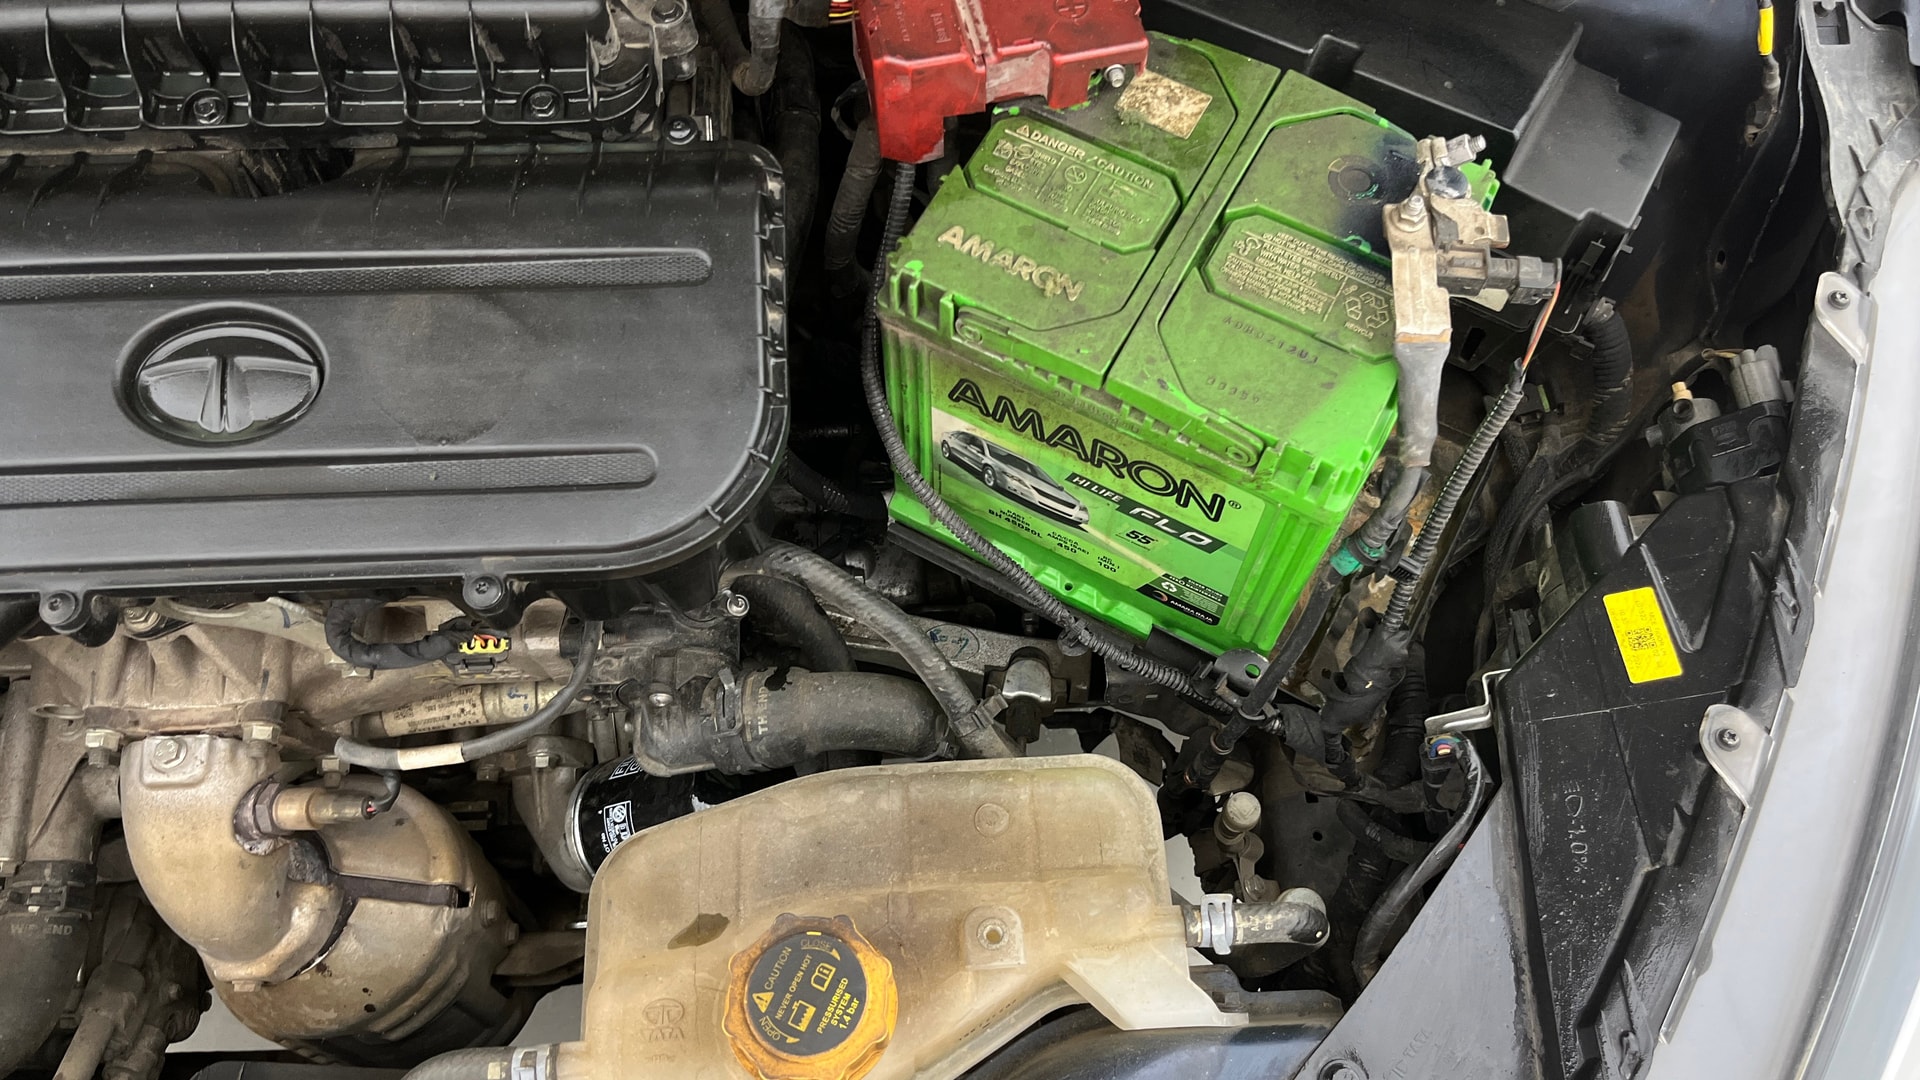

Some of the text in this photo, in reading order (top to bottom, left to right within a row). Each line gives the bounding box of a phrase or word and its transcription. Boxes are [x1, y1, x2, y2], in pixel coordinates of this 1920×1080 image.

[1029, 129, 1086, 159] DANGER
[1095, 158, 1155, 189] CAUTION
[937, 225, 1085, 302] AMARON
[1259, 248, 1277, 261] WITH
[1300, 266, 1316, 277] GET
[1262, 241, 1285, 256] FLUSH
[1283, 250, 1302, 263] EYES
[1254, 255, 1283, 272] MEDICAL
[1282, 267, 1300, 280] HELP
[1343, 321, 1374, 338] RECYCLE
[948, 378, 1227, 523] AMARON
[1072, 476, 1123, 502] HI LIFE
[1126, 530, 1155, 545] 55
[1129, 507, 1212, 546] FLO
[1056, 541, 1077, 553] 450
[1096, 560, 1116, 572] 100
[800, 939, 832, 949] CLOSE
[764, 946, 792, 990] CAUTION
[775, 954, 813, 1020] NEVER OPEN HOT
[816, 977, 849, 1034] PRESSURISED
[830, 992, 852, 1026] SYSTEM
[839, 998, 860, 1030] 1.4 bar
[758, 1016, 781, 1041] OPEN
